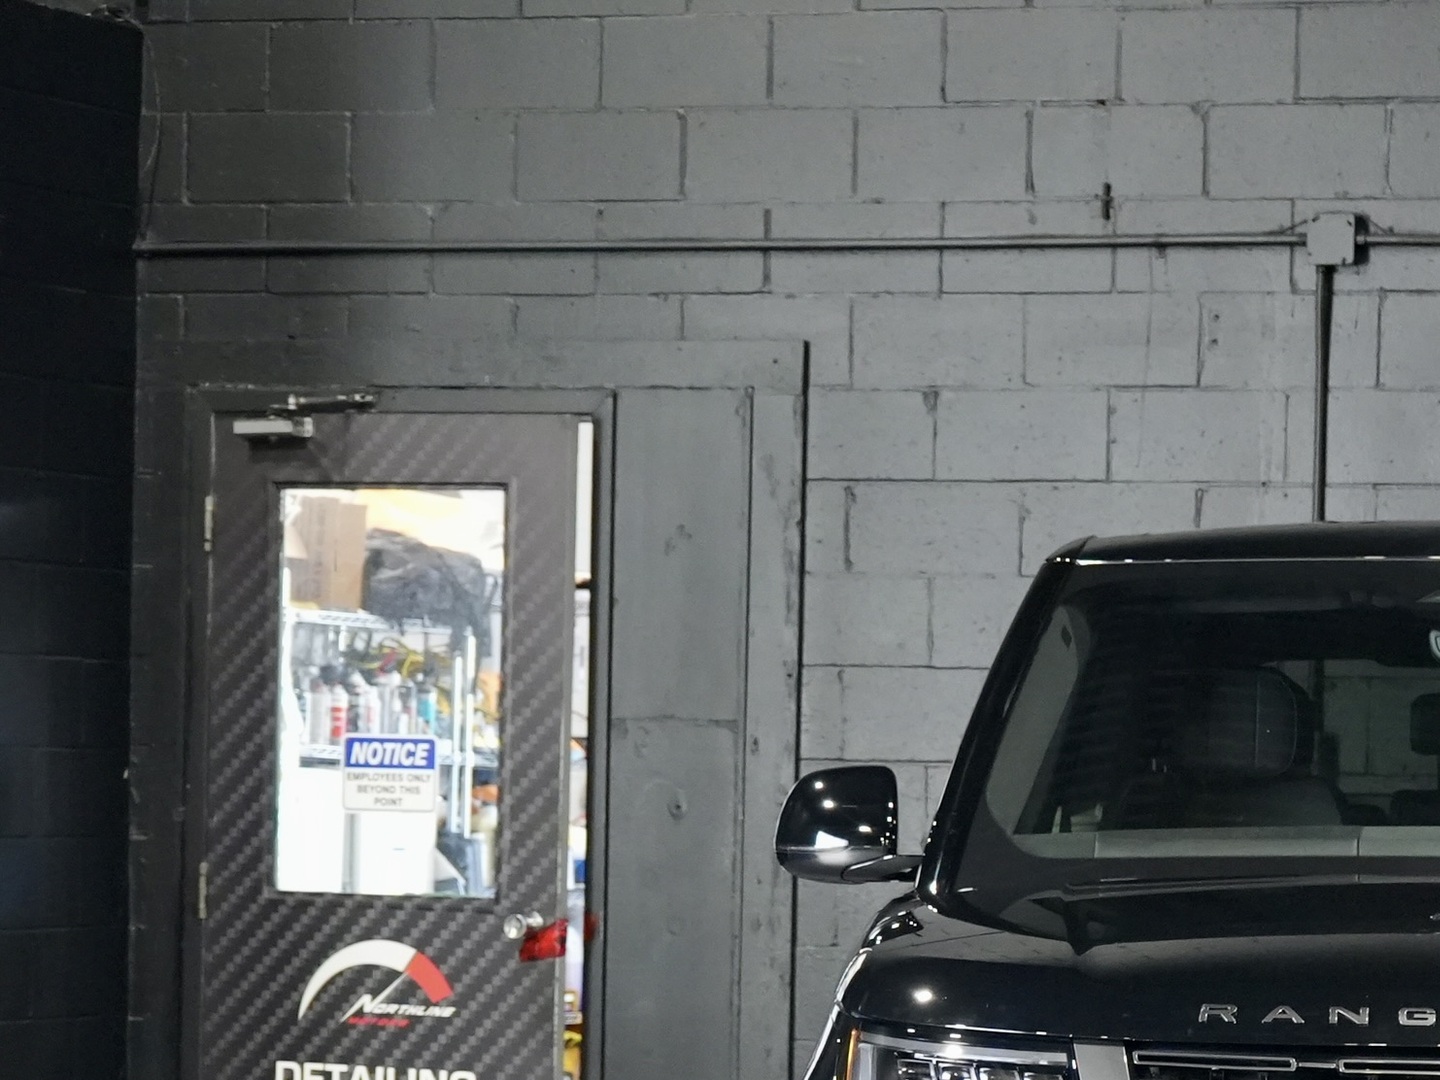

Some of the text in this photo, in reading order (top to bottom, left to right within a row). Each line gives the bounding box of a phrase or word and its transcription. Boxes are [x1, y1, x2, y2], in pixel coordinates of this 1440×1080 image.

[349, 741, 430, 767] NOTICE
[346, 773, 431, 782] EMPLOYEES ONLY
[357, 785, 420, 794] BEYOND THIS
[374, 797, 402, 806] POINT
